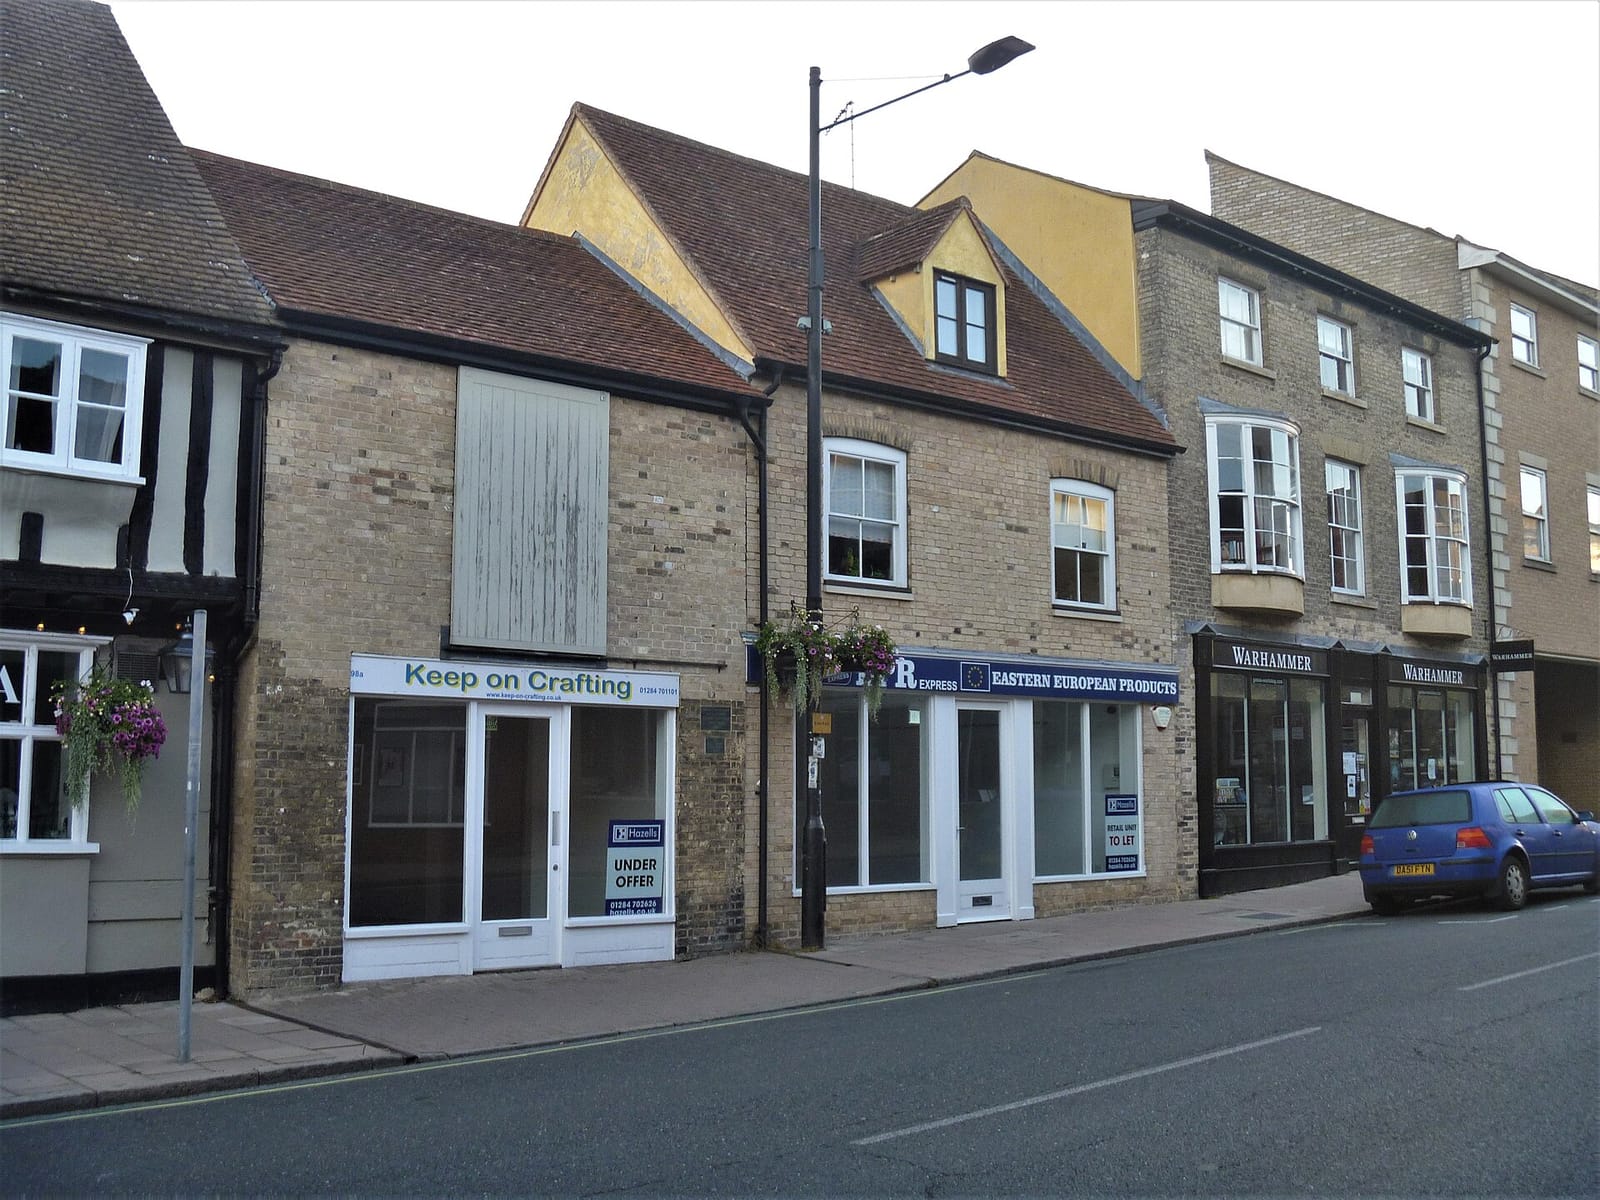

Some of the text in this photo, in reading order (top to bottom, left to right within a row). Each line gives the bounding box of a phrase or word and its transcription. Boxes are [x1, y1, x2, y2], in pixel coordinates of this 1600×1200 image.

[1232, 646, 1312, 672] WARHAMMER
[1403, 663, 1464, 685] WARHAMMER
[406, 663, 633, 703] Keep on Crafting
[919, 679, 958, 692] EXPRESS
[991, 670, 1177, 695] EASTERN EUROPEAN PRODUCTS
[639, 686, 678, 696] 01284 701101
[629, 828, 658, 839] Hazells
[1107, 824, 1136, 832] RETAIL UNIT
[1109, 835, 1135, 846] TO LET
[614, 859, 657, 871] UNDER
[616, 876, 654, 887] OFFER
[610, 900, 657, 909] 01284 702626
